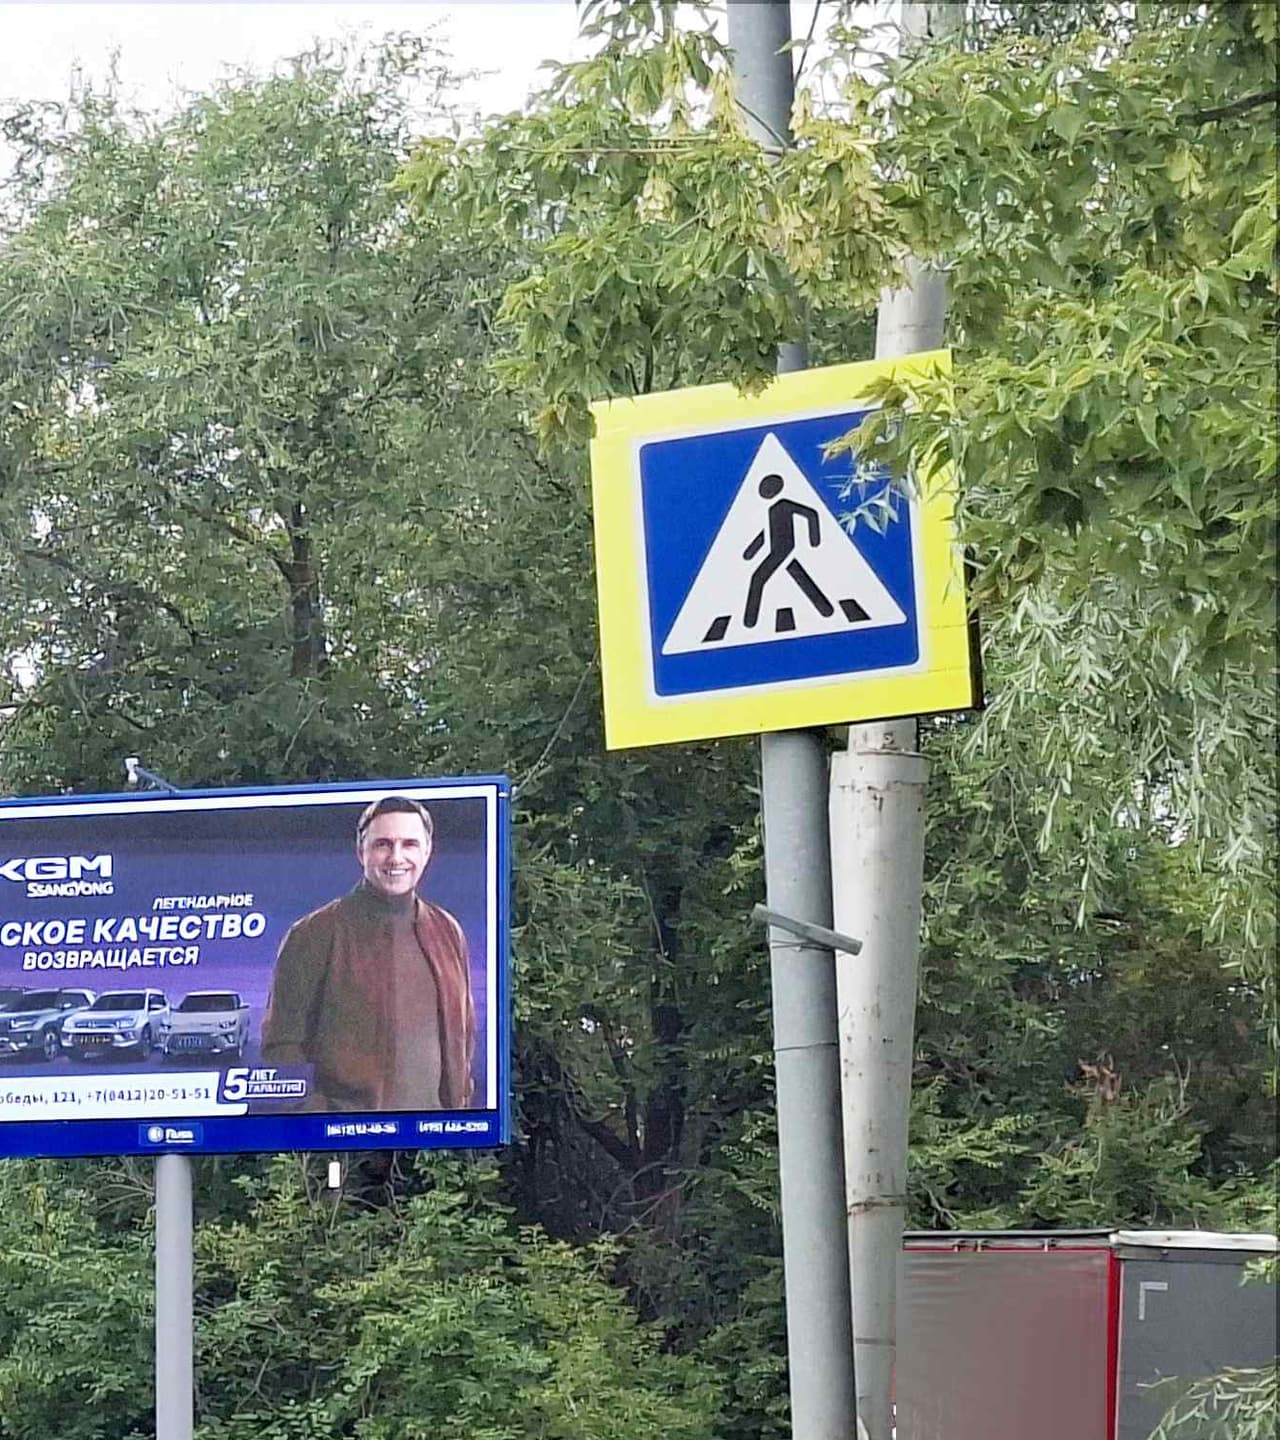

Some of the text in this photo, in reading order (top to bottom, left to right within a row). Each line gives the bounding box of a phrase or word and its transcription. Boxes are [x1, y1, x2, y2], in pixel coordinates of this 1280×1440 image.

[152, 893, 254, 910] ЛЕГЕНДАРНОЕ
[92, 912, 267, 944] КАЧЕСТВО
[22, 946, 200, 971] ВОЗВРАЩАЕТСЯ
[223, 1067, 278, 1100] 5 ЛЕТ
